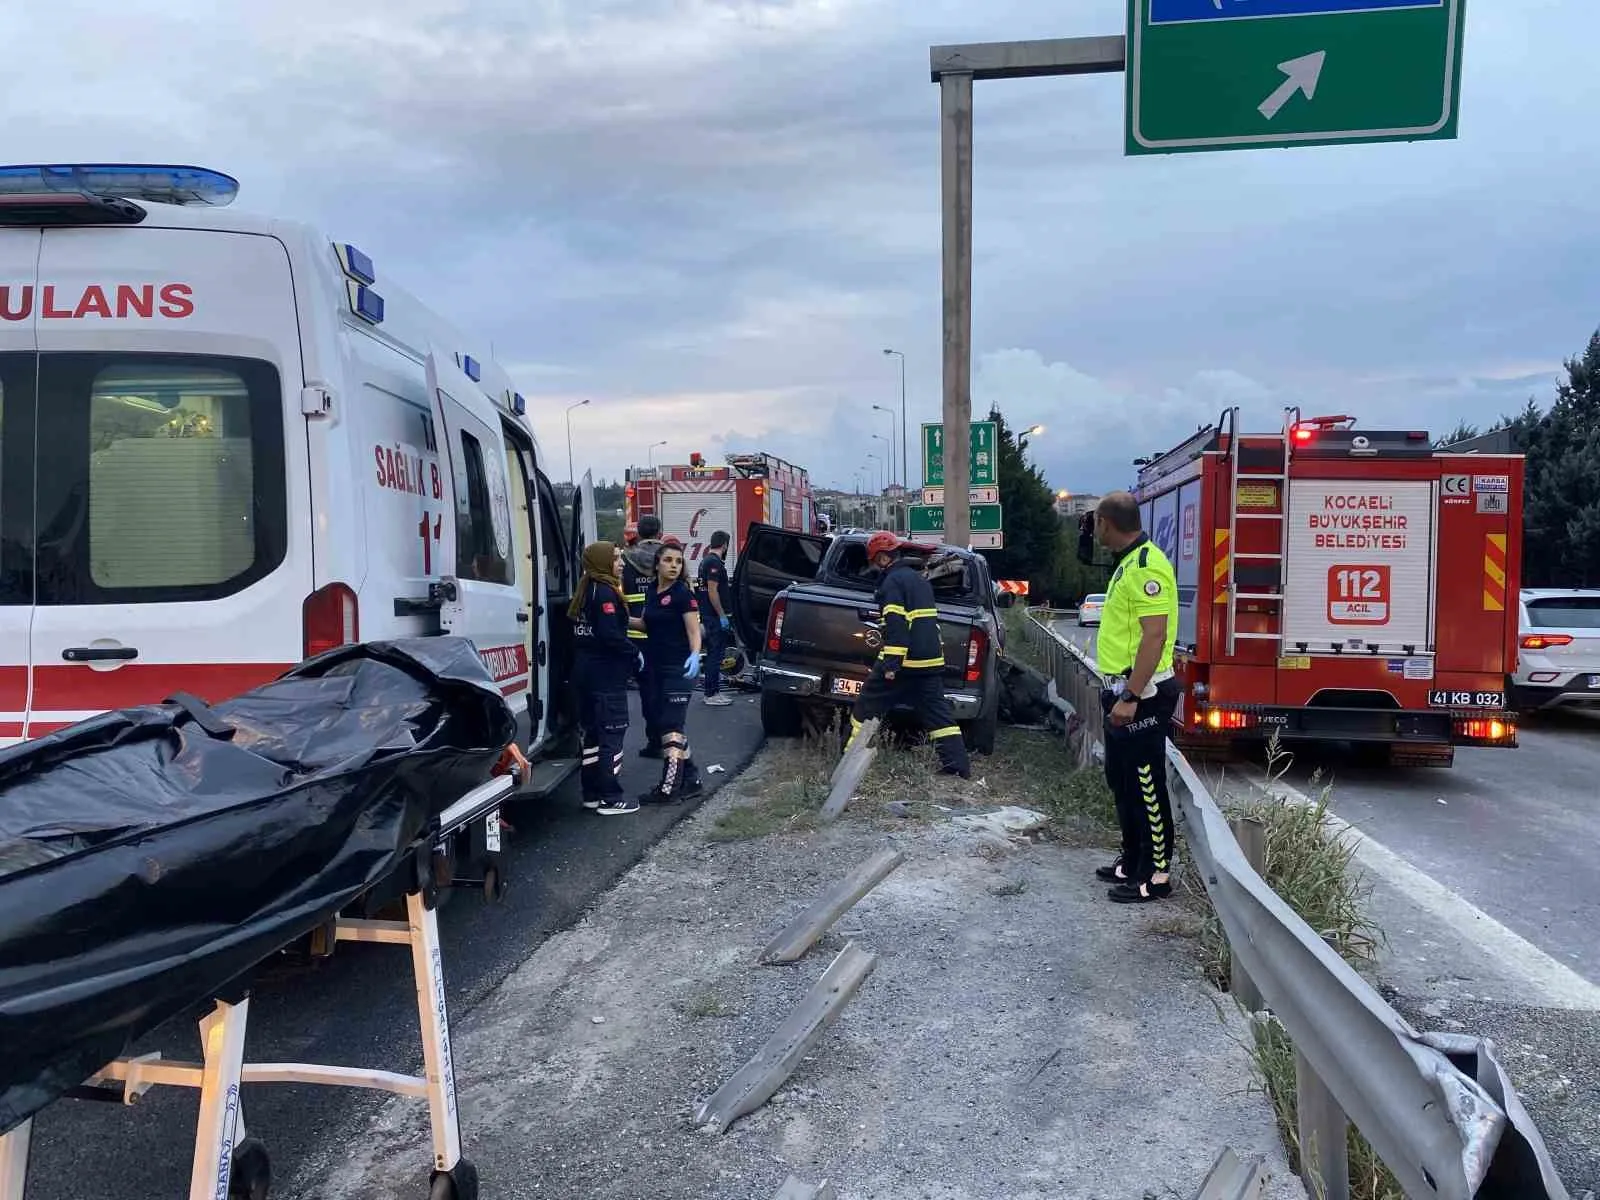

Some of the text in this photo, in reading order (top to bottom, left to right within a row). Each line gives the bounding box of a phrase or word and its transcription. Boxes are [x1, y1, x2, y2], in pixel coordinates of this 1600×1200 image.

[374, 442, 426, 497] SAĞLIK
[1337, 570, 1381, 597] 112
[1434, 692, 1499, 705] 41 KB 032
